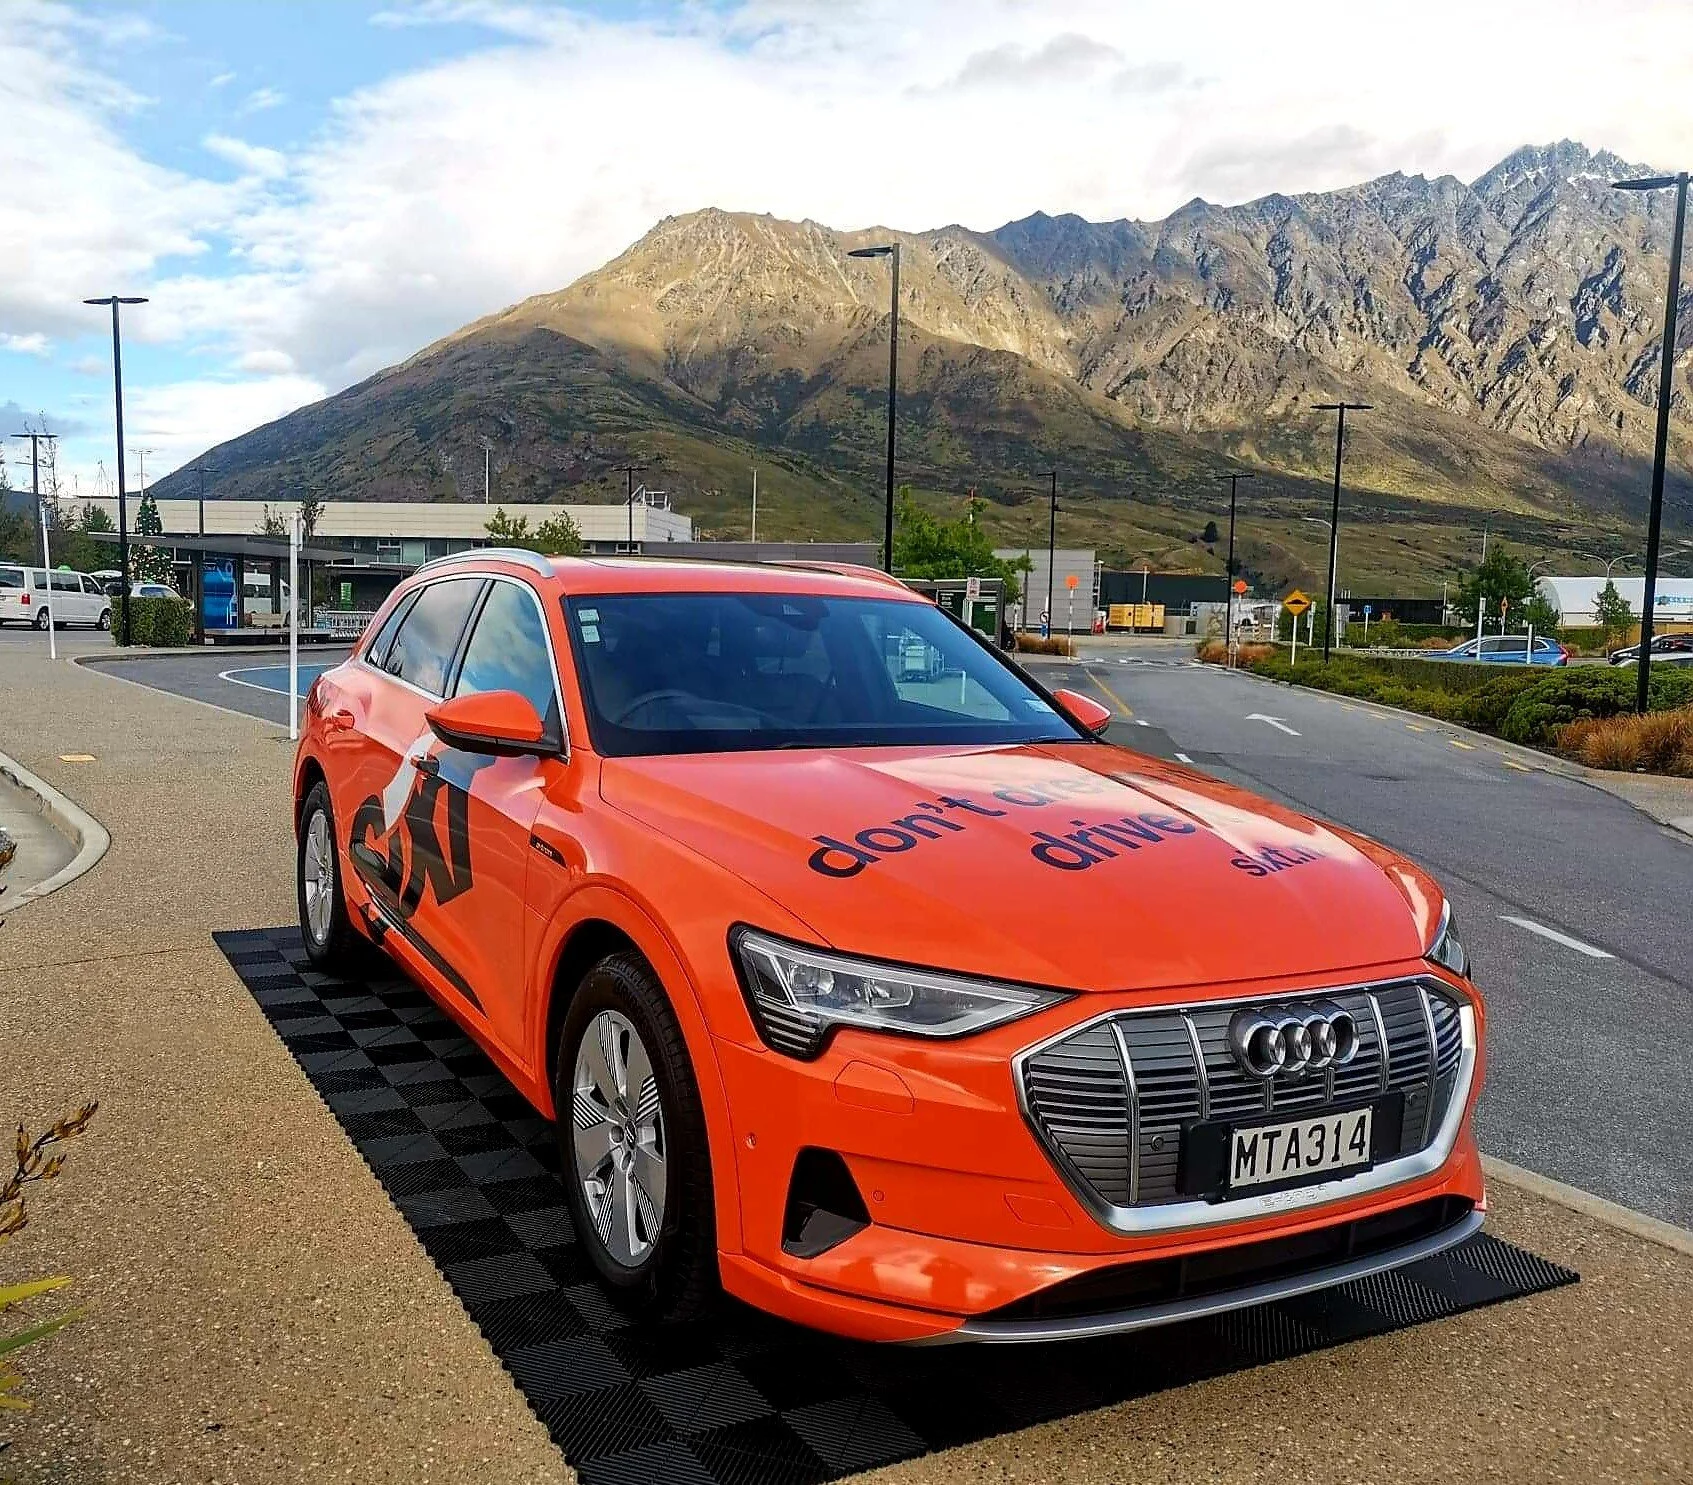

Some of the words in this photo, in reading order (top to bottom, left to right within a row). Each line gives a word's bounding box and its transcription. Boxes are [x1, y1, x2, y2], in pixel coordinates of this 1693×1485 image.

[808, 796, 1007, 878] don't
[1030, 812, 1196, 871] drive
[1234, 1114, 1367, 1180] MTA314
